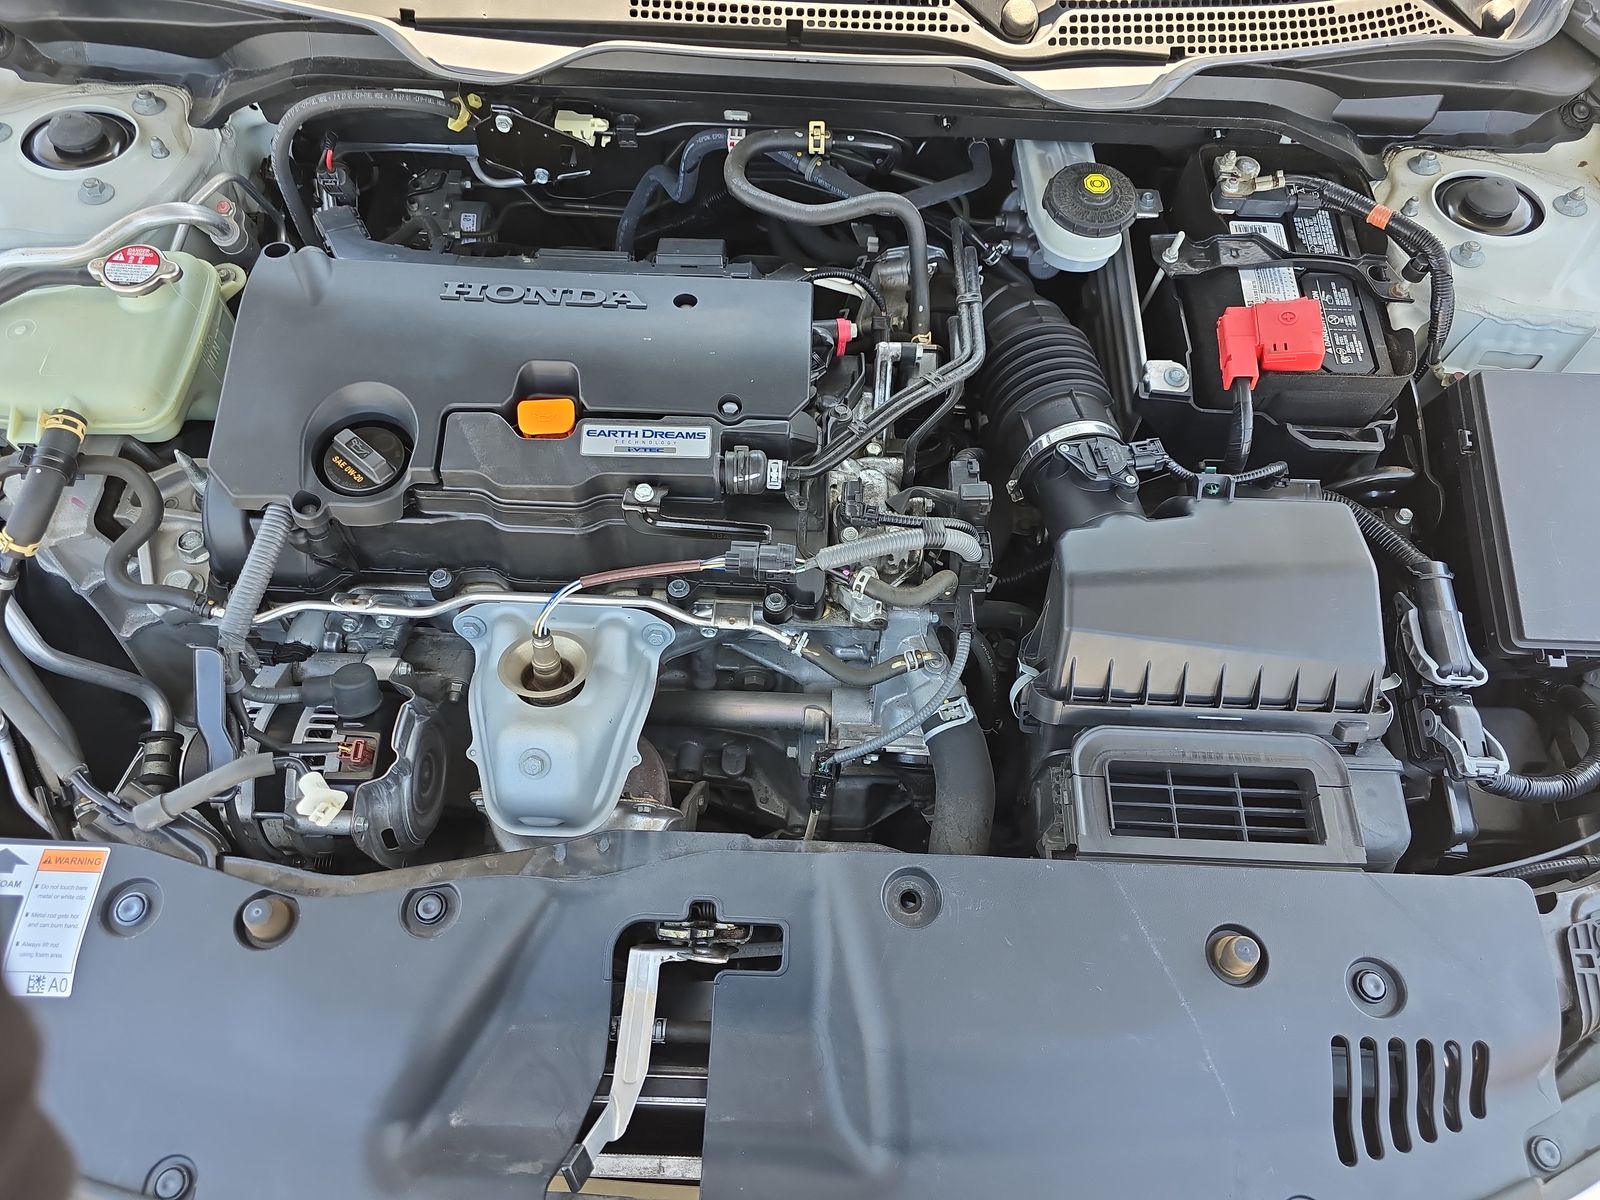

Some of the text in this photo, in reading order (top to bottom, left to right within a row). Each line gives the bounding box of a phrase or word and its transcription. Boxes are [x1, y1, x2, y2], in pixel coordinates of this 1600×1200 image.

[440, 281, 648, 309] HONDA
[586, 429, 707, 440] EARTH DREAMS
[332, 455, 348, 468] SAE
[344, 465, 364, 483] 0W-20
[55, 857, 102, 866] WARNING
[48, 977, 68, 993] A0
